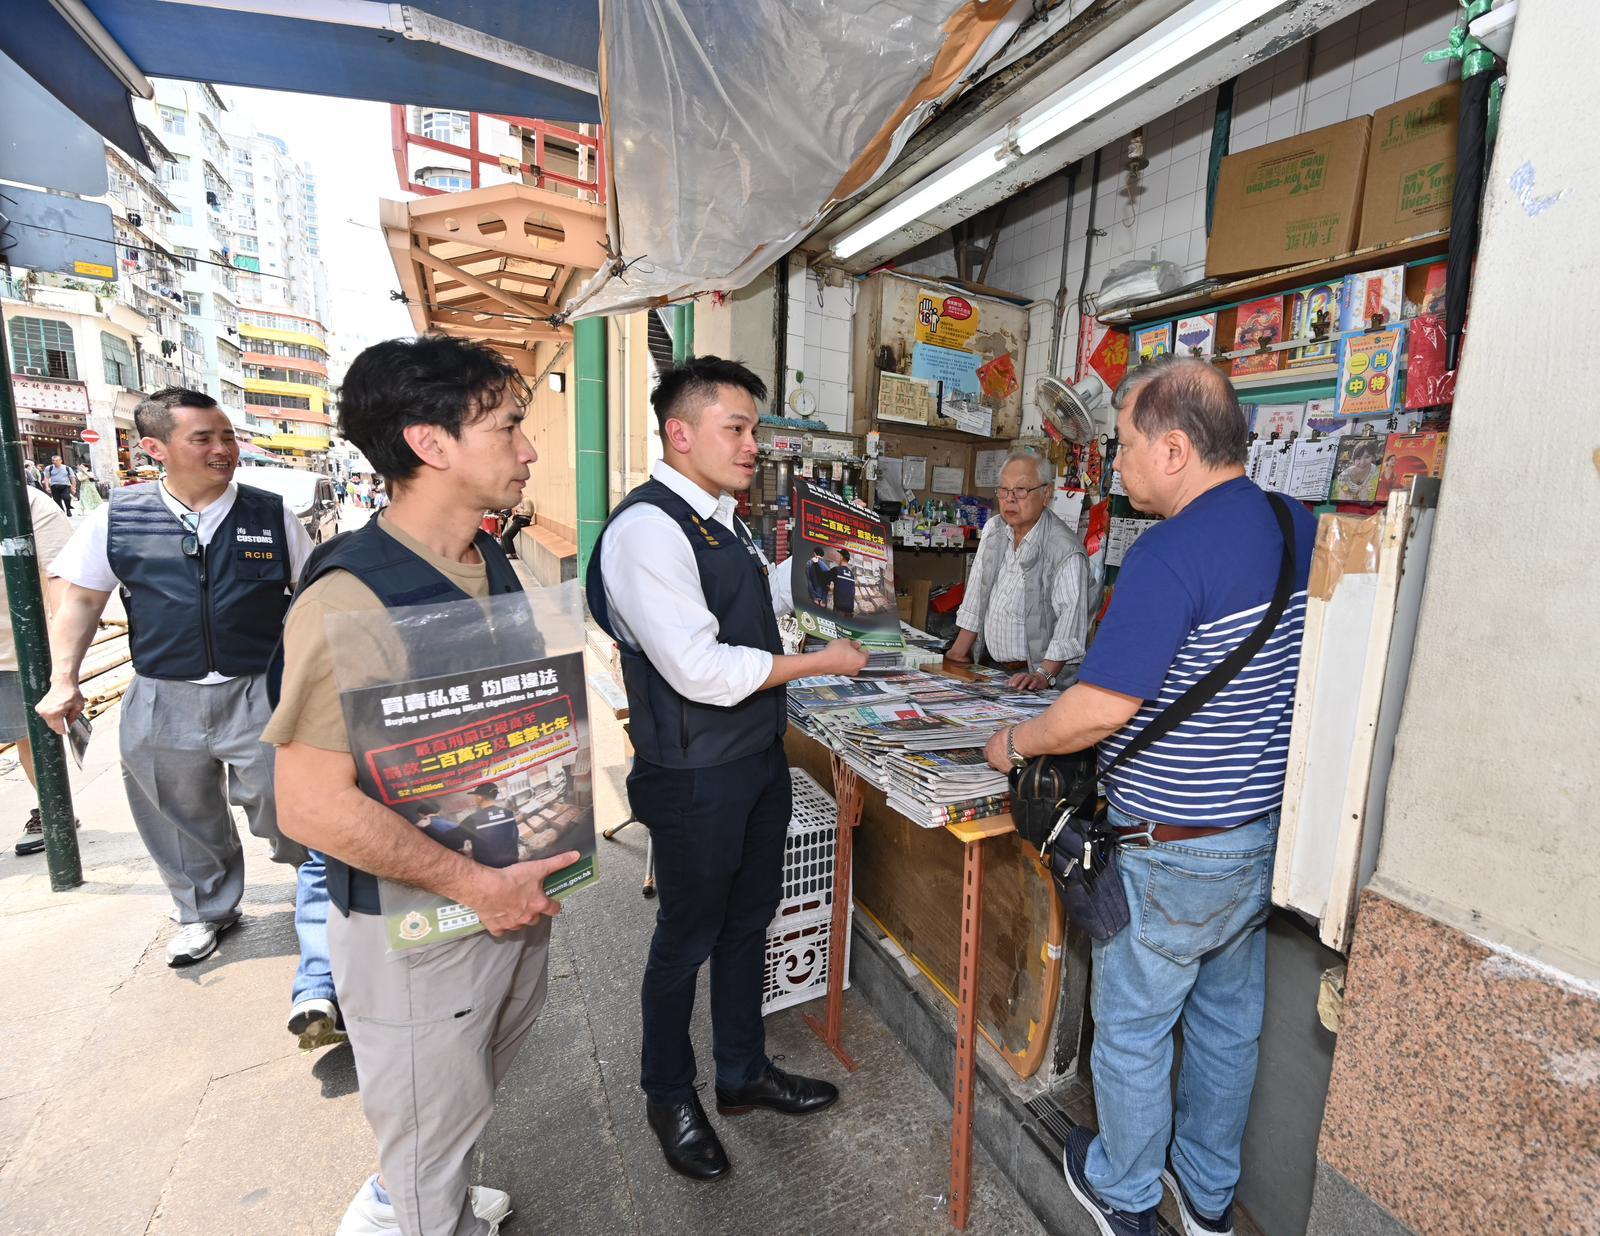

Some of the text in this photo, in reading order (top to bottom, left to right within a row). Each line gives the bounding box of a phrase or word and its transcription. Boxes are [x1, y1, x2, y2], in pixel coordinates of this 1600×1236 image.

[1304, 168, 1323, 182] My
[1403, 181, 1425, 196] My
[920, 311, 930, 323] 18
[1103, 334, 1128, 368] 福
[236, 534, 273, 544] CUSTOMS
[245, 551, 273, 559] RCIB
[381, 668, 558, 716] 買賣私煙 均屬違法
[384, 715, 418, 727] Buying
[419, 713, 430, 721] or
[431, 707, 461, 719] selling
[485, 694, 526, 708] cigarettes
[526, 691, 535, 699] is
[535, 686, 559, 697] illegal
[412, 782, 445, 794] million
[483, 768, 489, 776] 7
